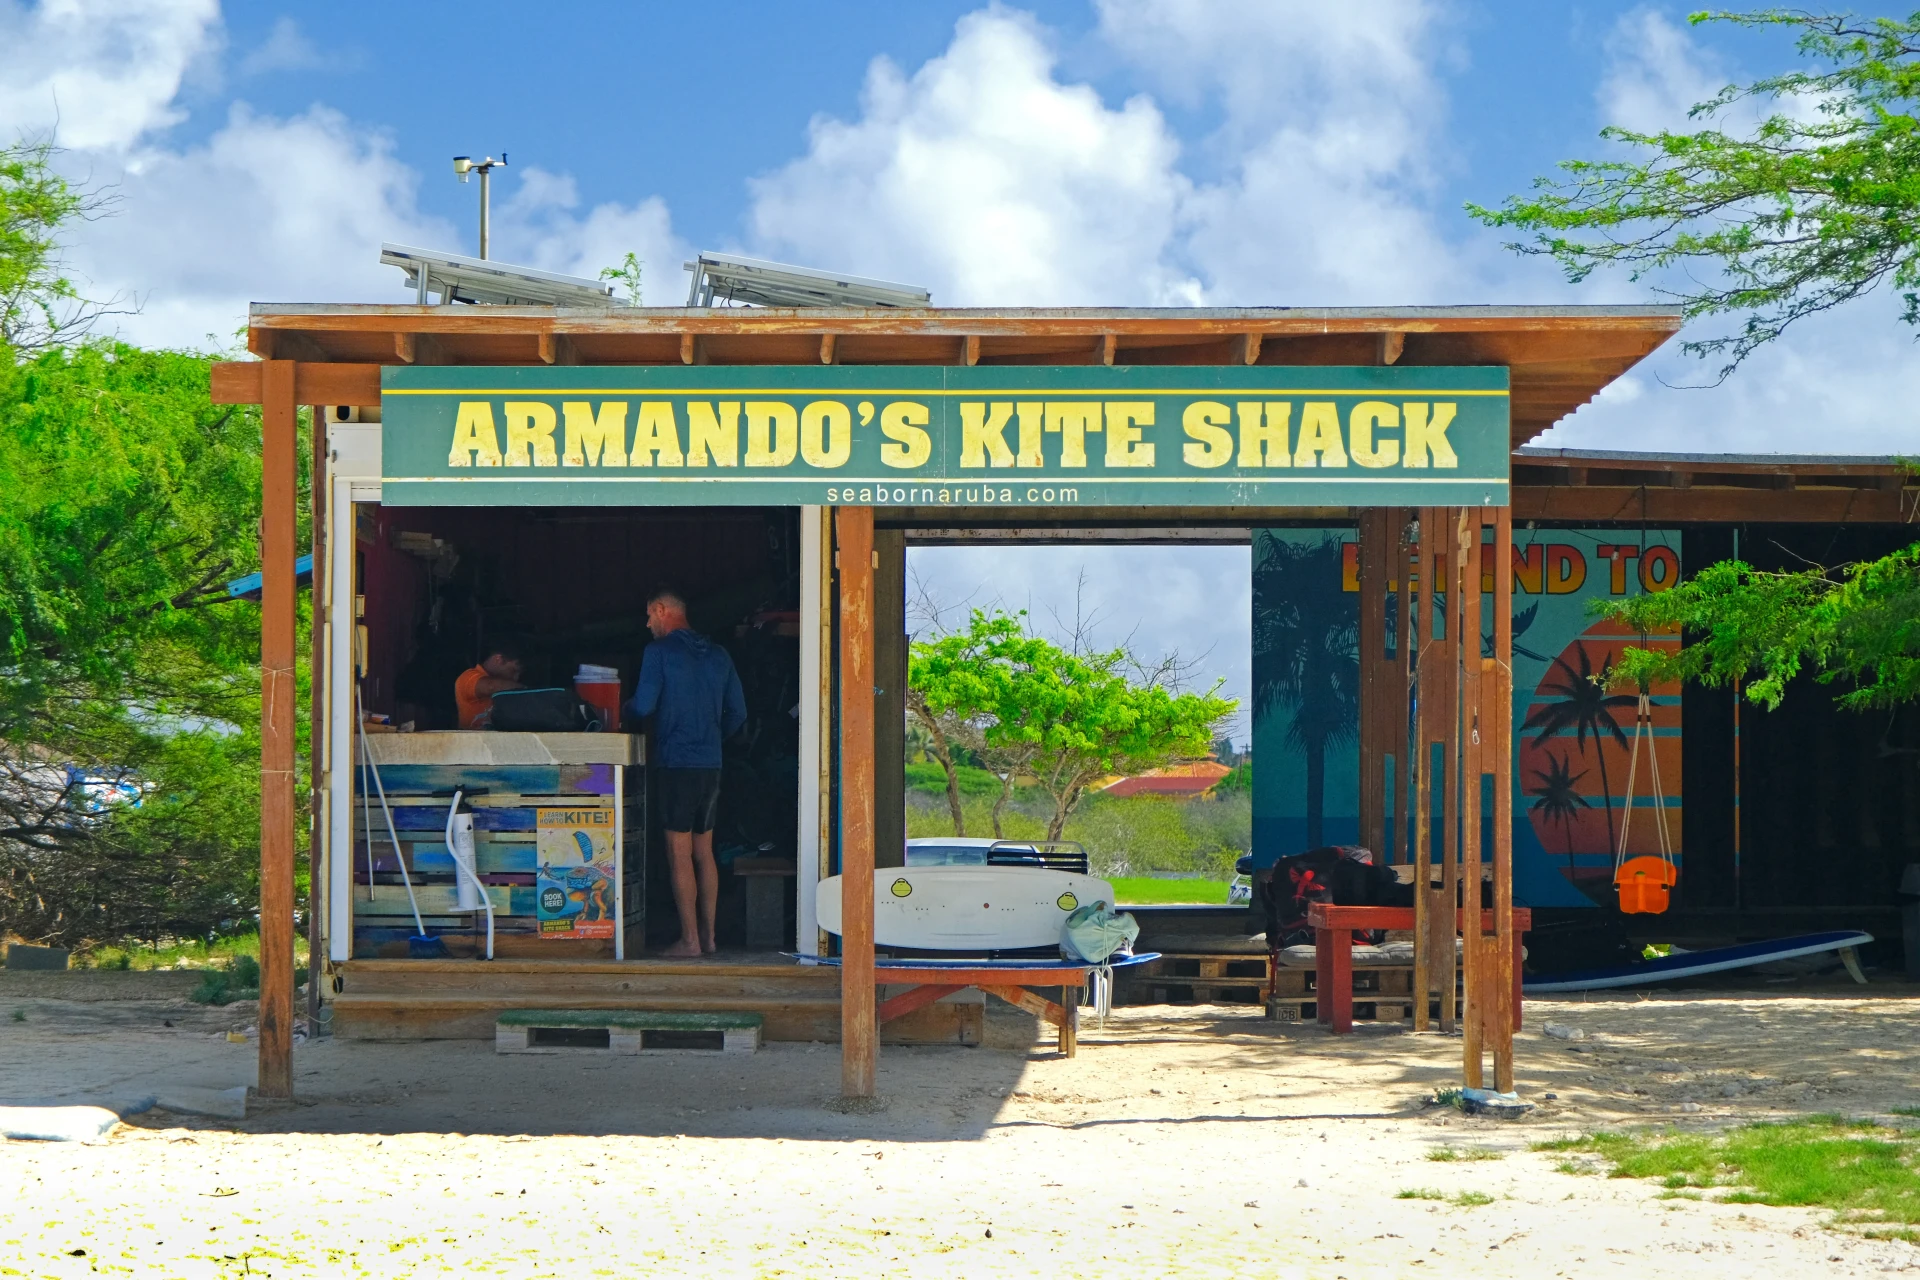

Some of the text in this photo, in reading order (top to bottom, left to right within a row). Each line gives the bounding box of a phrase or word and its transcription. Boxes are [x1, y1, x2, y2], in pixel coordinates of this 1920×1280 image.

[448, 400, 1459, 469] ARMANDO’S KITE SHACK
[826, 484, 1079, 503] seabornaruba.com
[1597, 544, 1680, 595] TO
[564, 811, 608, 824] KITE!
[544, 893, 562, 901] BOOK
[545, 899, 563, 908] HERE!
